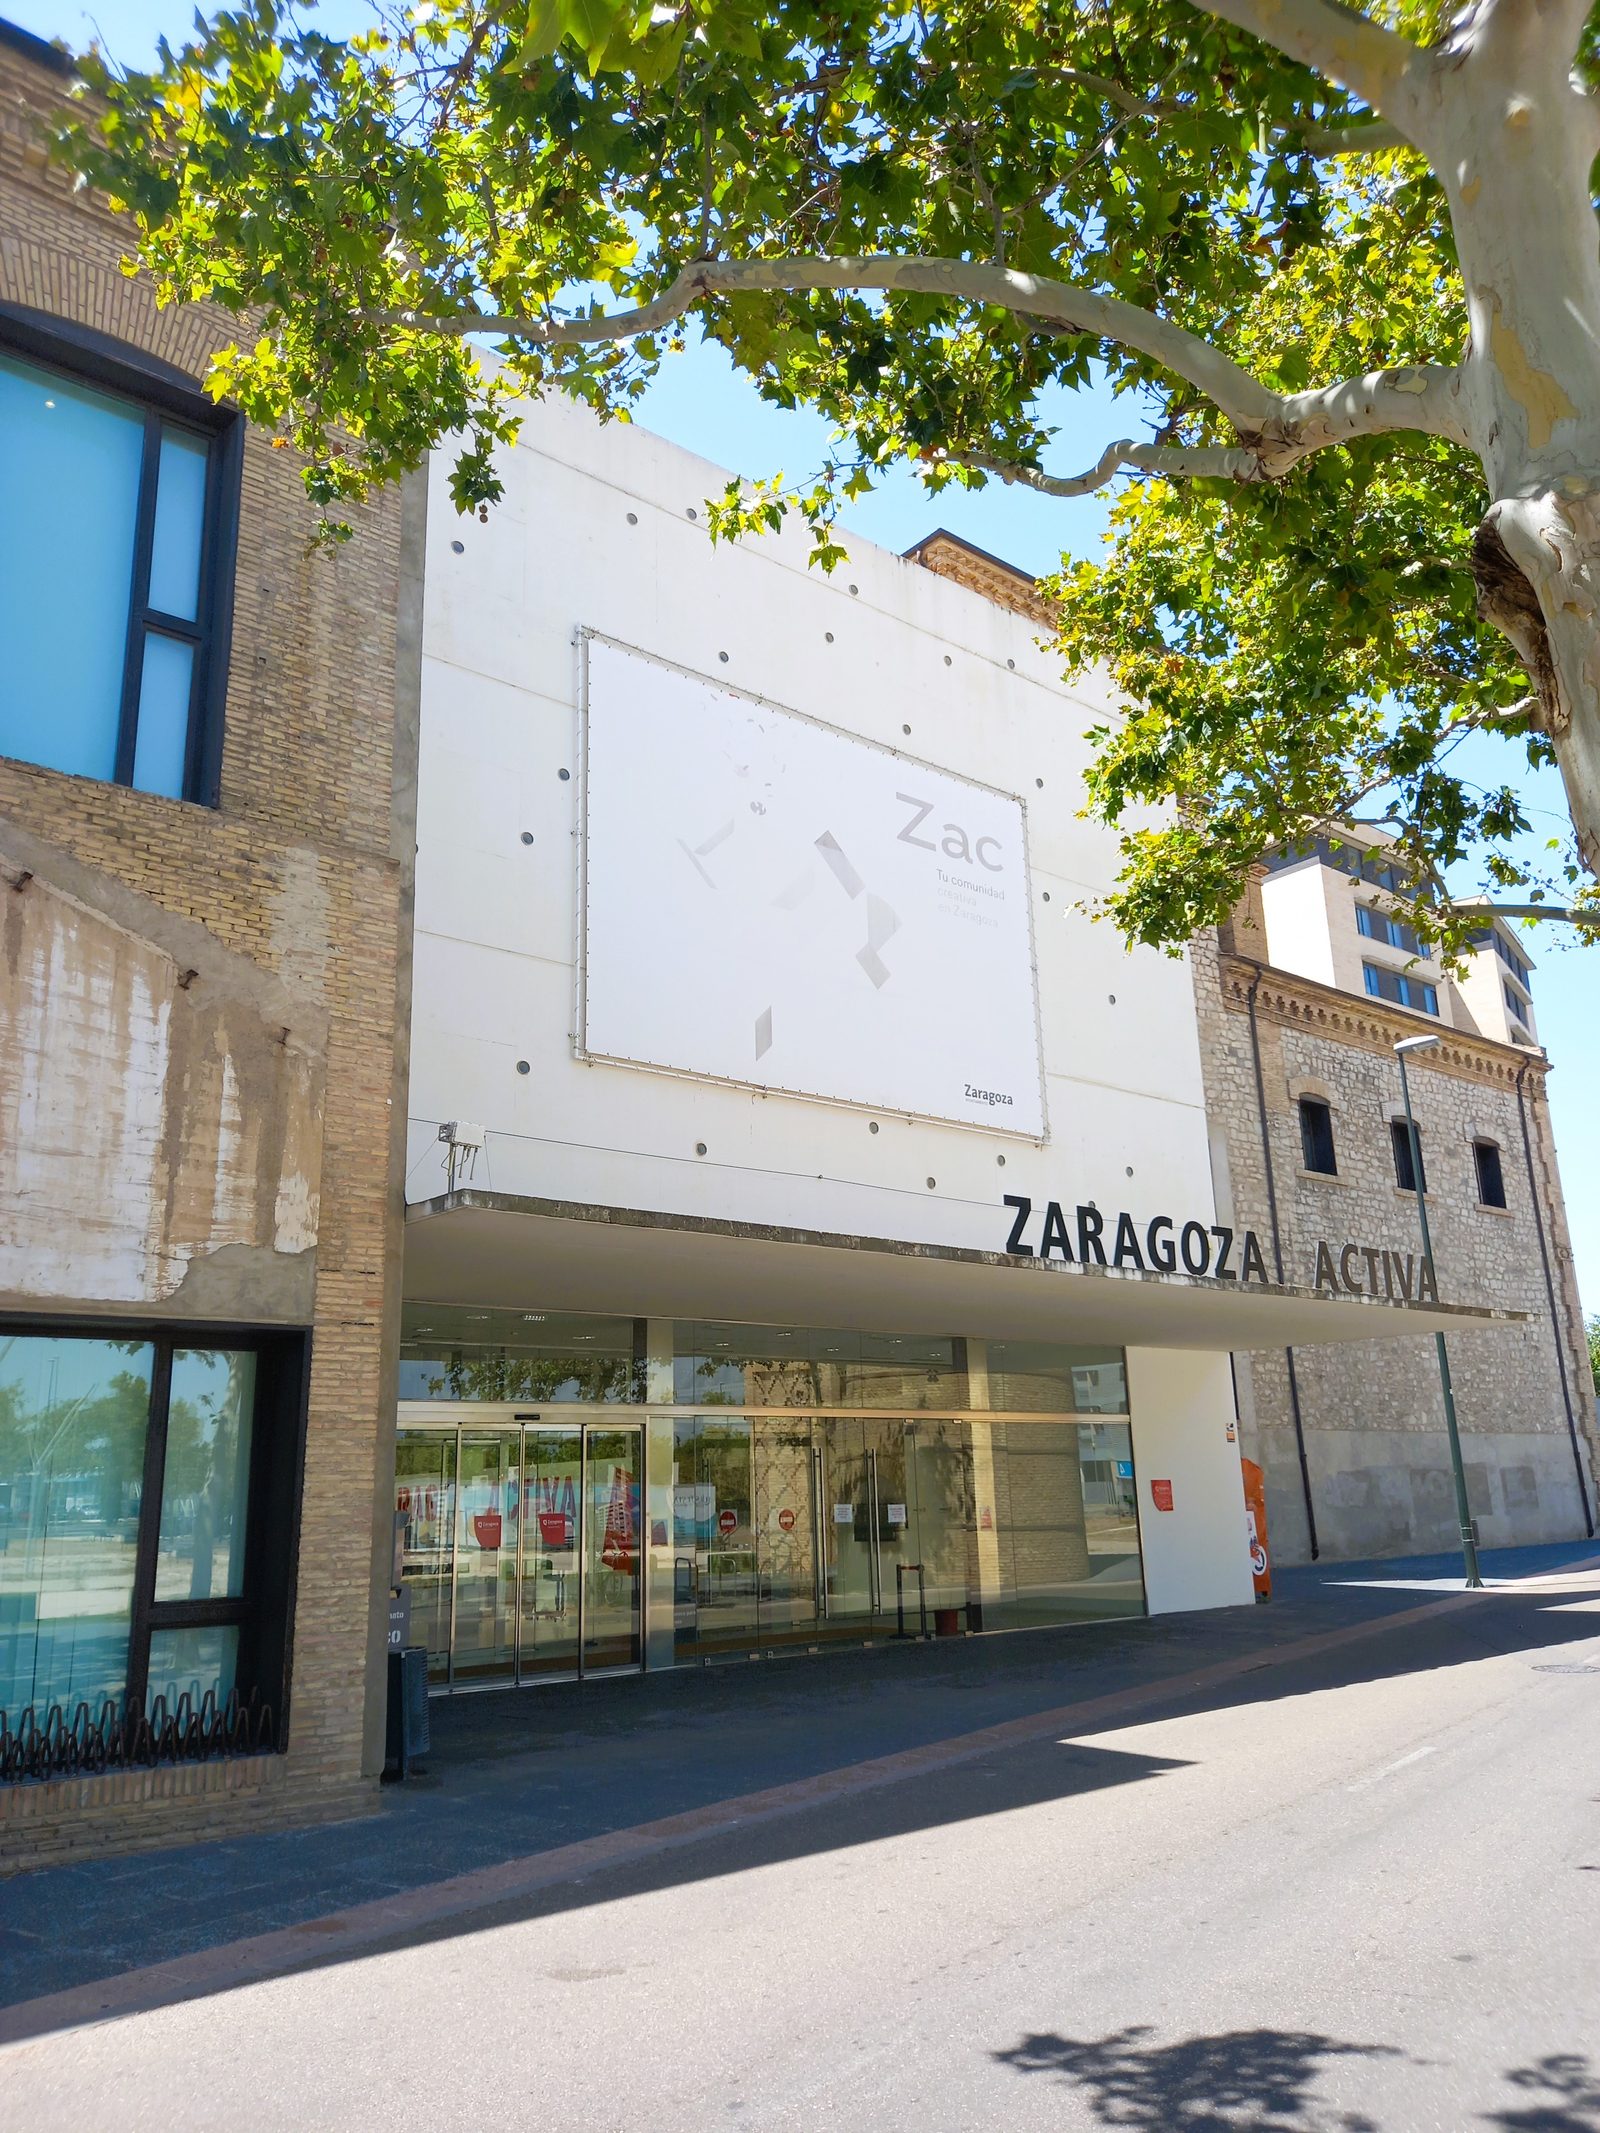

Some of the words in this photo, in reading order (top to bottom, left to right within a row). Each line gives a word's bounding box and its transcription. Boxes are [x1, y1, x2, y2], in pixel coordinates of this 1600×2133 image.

[896, 791, 1004, 872] Zac
[936, 868, 949, 882] Tu
[951, 877, 1005, 901] comunidad
[937, 887, 977, 907] creativa
[937, 903, 951, 913] en
[953, 904, 999, 928] Zaragoza
[964, 1084, 1013, 1106] Zaragoza
[1003, 1194, 1269, 1284] ZARAGOZA
[1315, 1241, 1438, 1302] ACTIVA
